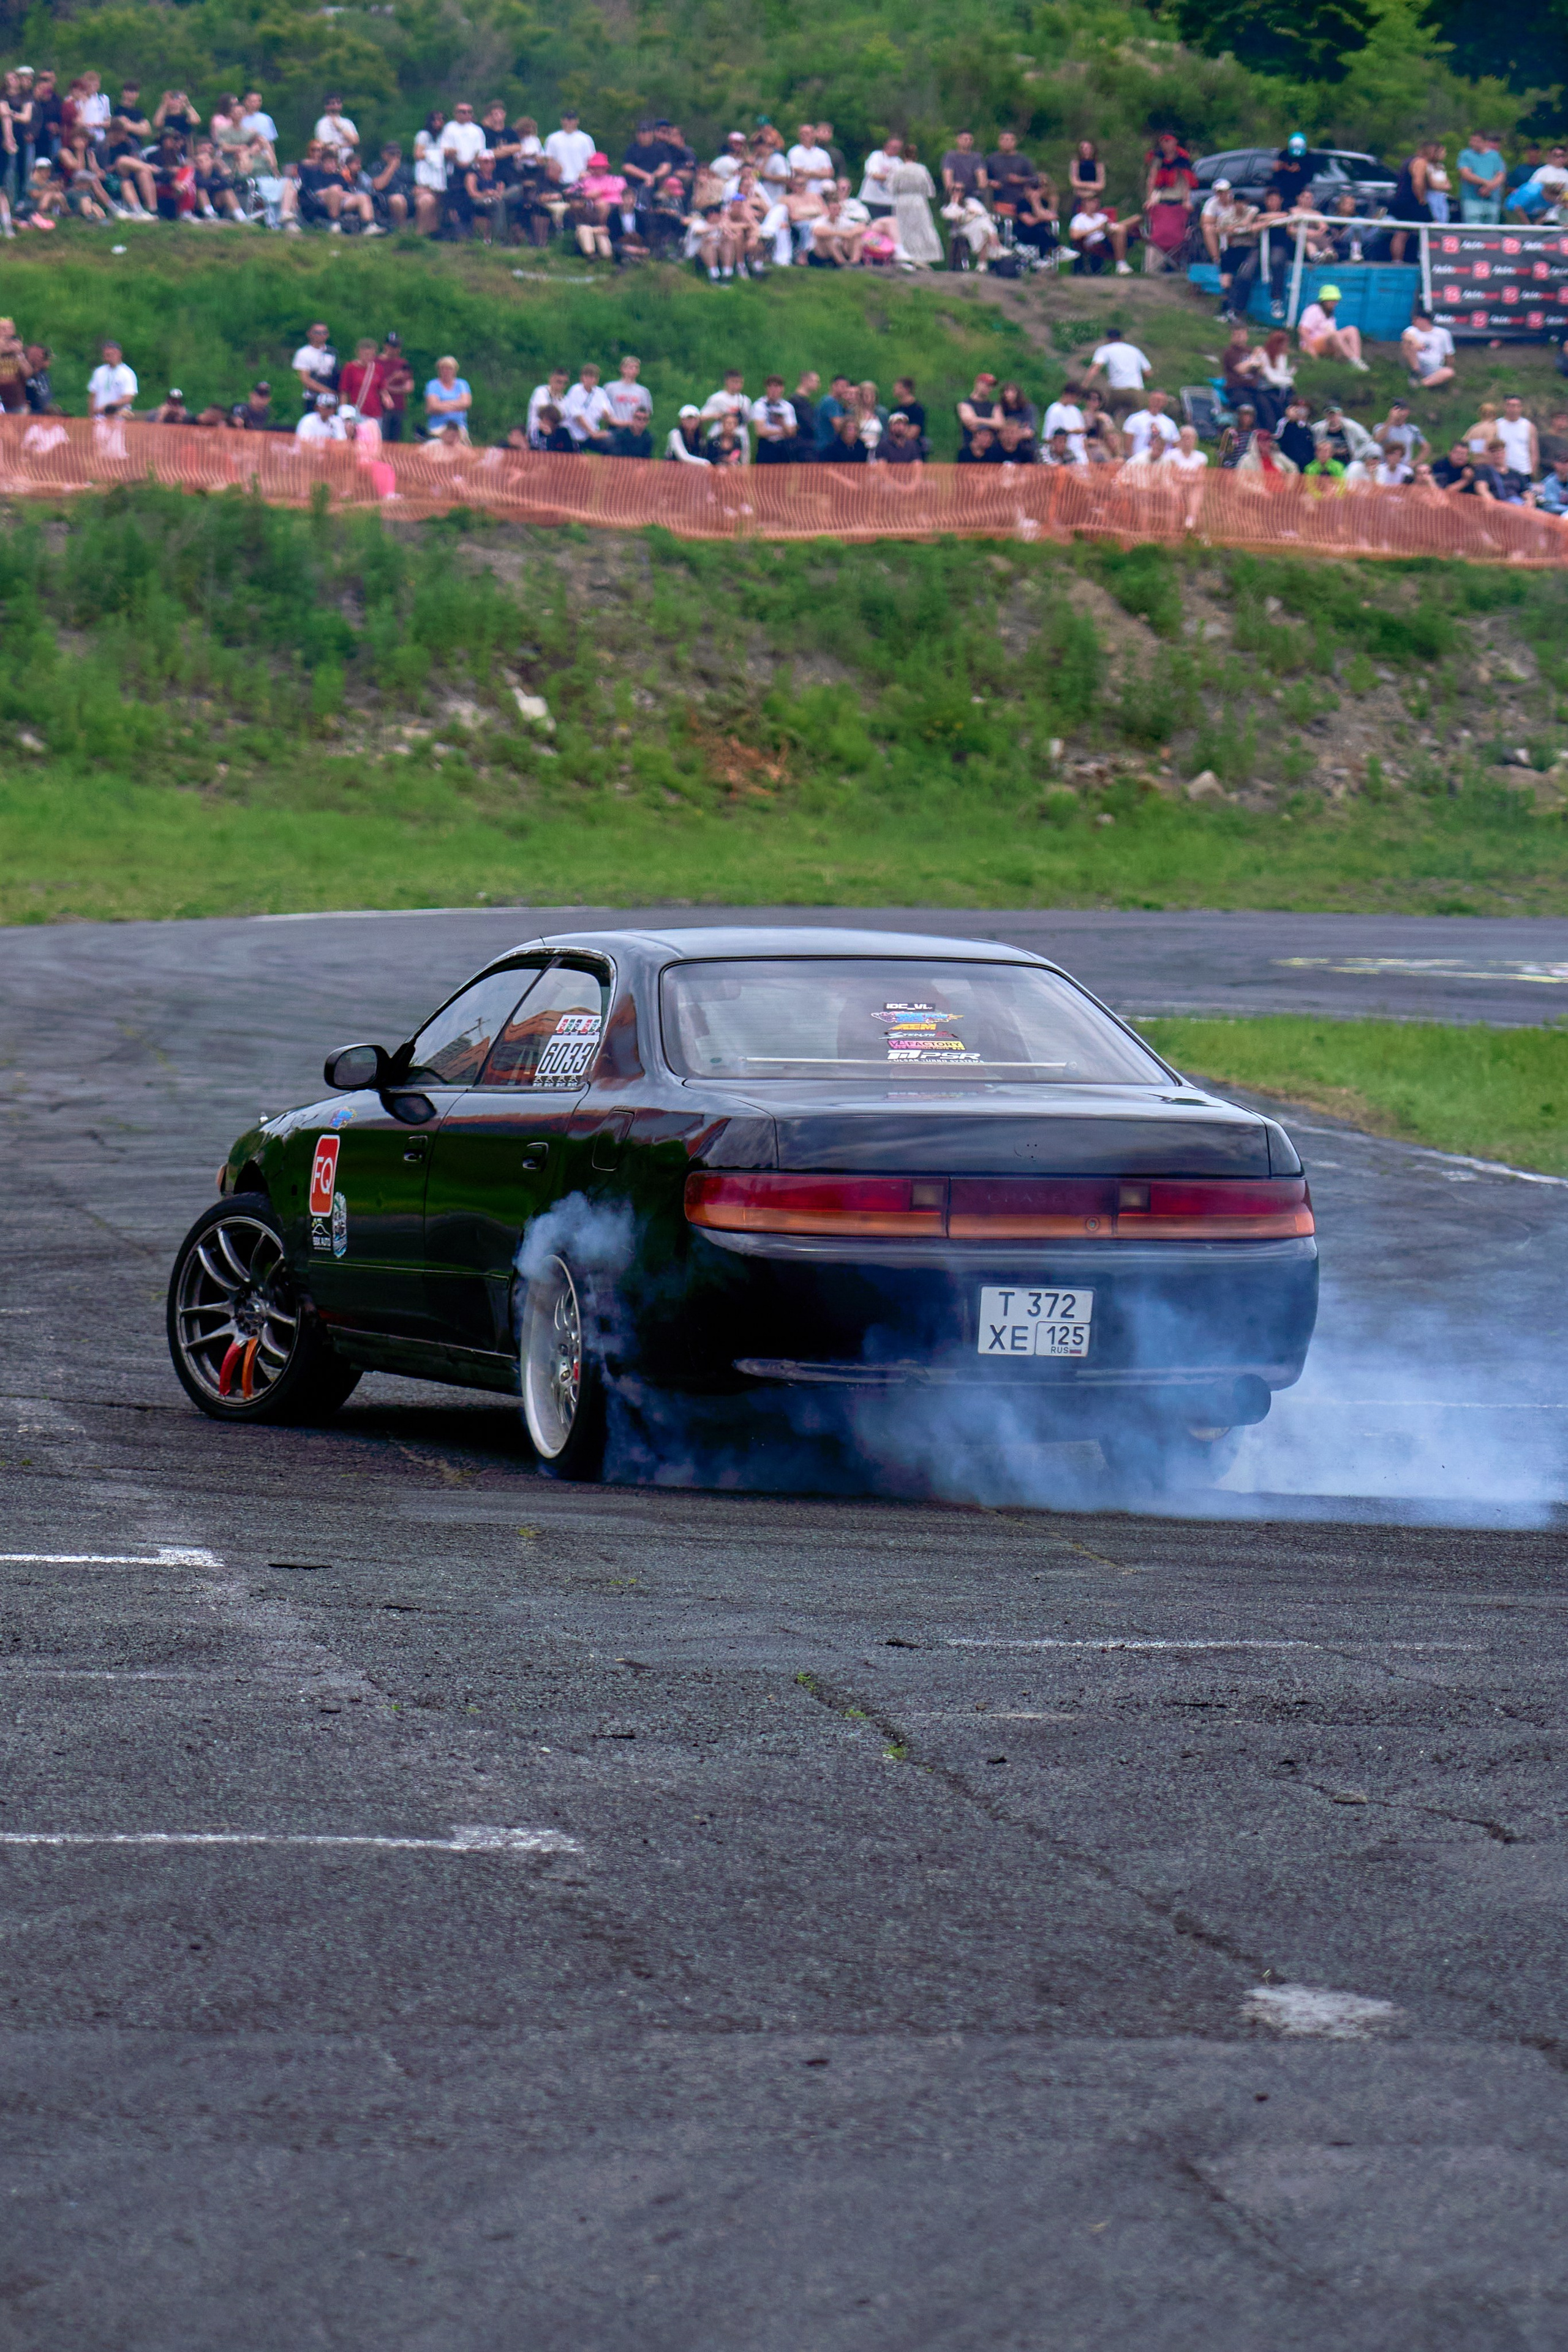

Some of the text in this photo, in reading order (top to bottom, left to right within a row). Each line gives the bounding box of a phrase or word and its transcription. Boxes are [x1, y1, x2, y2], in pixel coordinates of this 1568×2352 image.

[537, 1042, 595, 1074] 6033
[312, 1156, 333, 1194] FQ
[998, 1291, 1076, 1319] T 372
[989, 1324, 1084, 1351] XE 125
